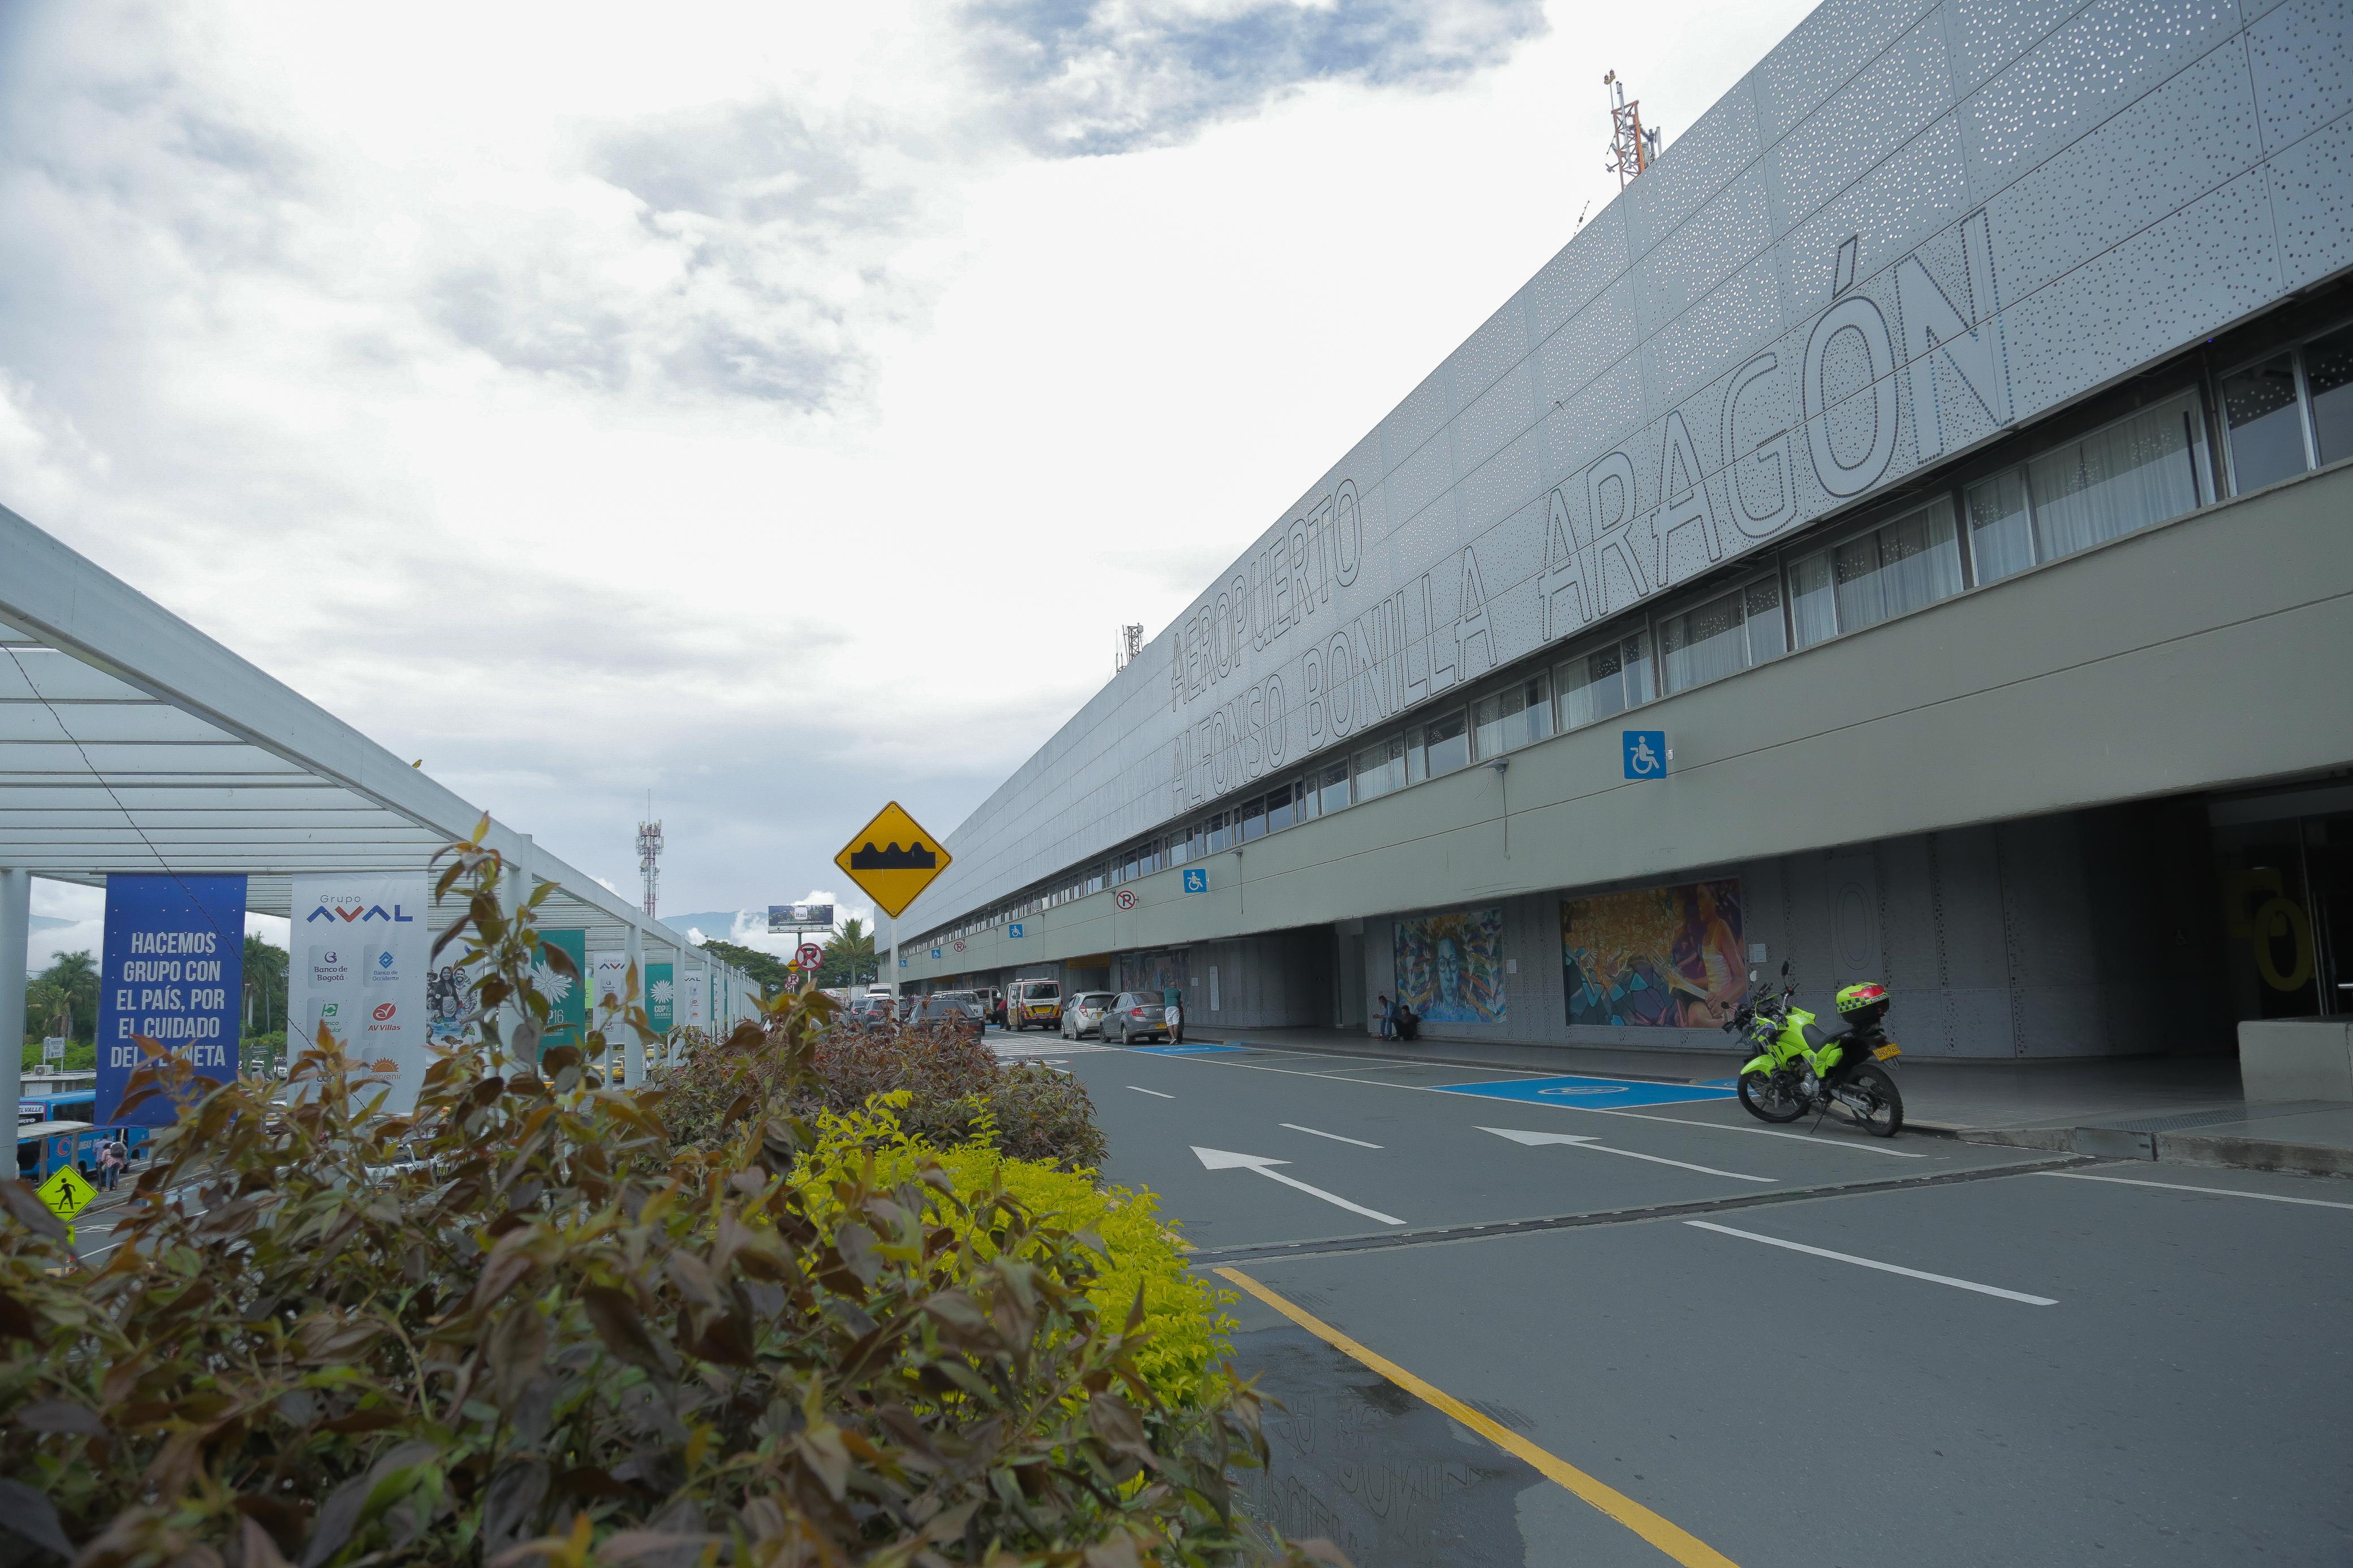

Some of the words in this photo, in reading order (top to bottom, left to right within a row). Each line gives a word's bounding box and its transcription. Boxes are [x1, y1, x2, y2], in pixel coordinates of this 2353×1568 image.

[1173, 674, 1287, 815] ALFONSO
[1303, 546, 1497, 751] BONILLA
[1538, 208, 2015, 642] ARAGÓN
[1171, 479, 1362, 712] AEROPUERTO
[320, 895, 361, 904] Grupo
[306, 905, 413, 923] AVAL
[131, 932, 217, 954] HACEMOS
[123, 961, 181, 982] GRUPO
[185, 961, 221, 982] CON
[317, 974, 344, 983] Bogotá
[117, 990, 137, 1010] EL
[141, 985, 186, 1012] PAÍS,
[191, 989, 225, 1010] POR
[144, 1017, 220, 1039] CUIDADO
